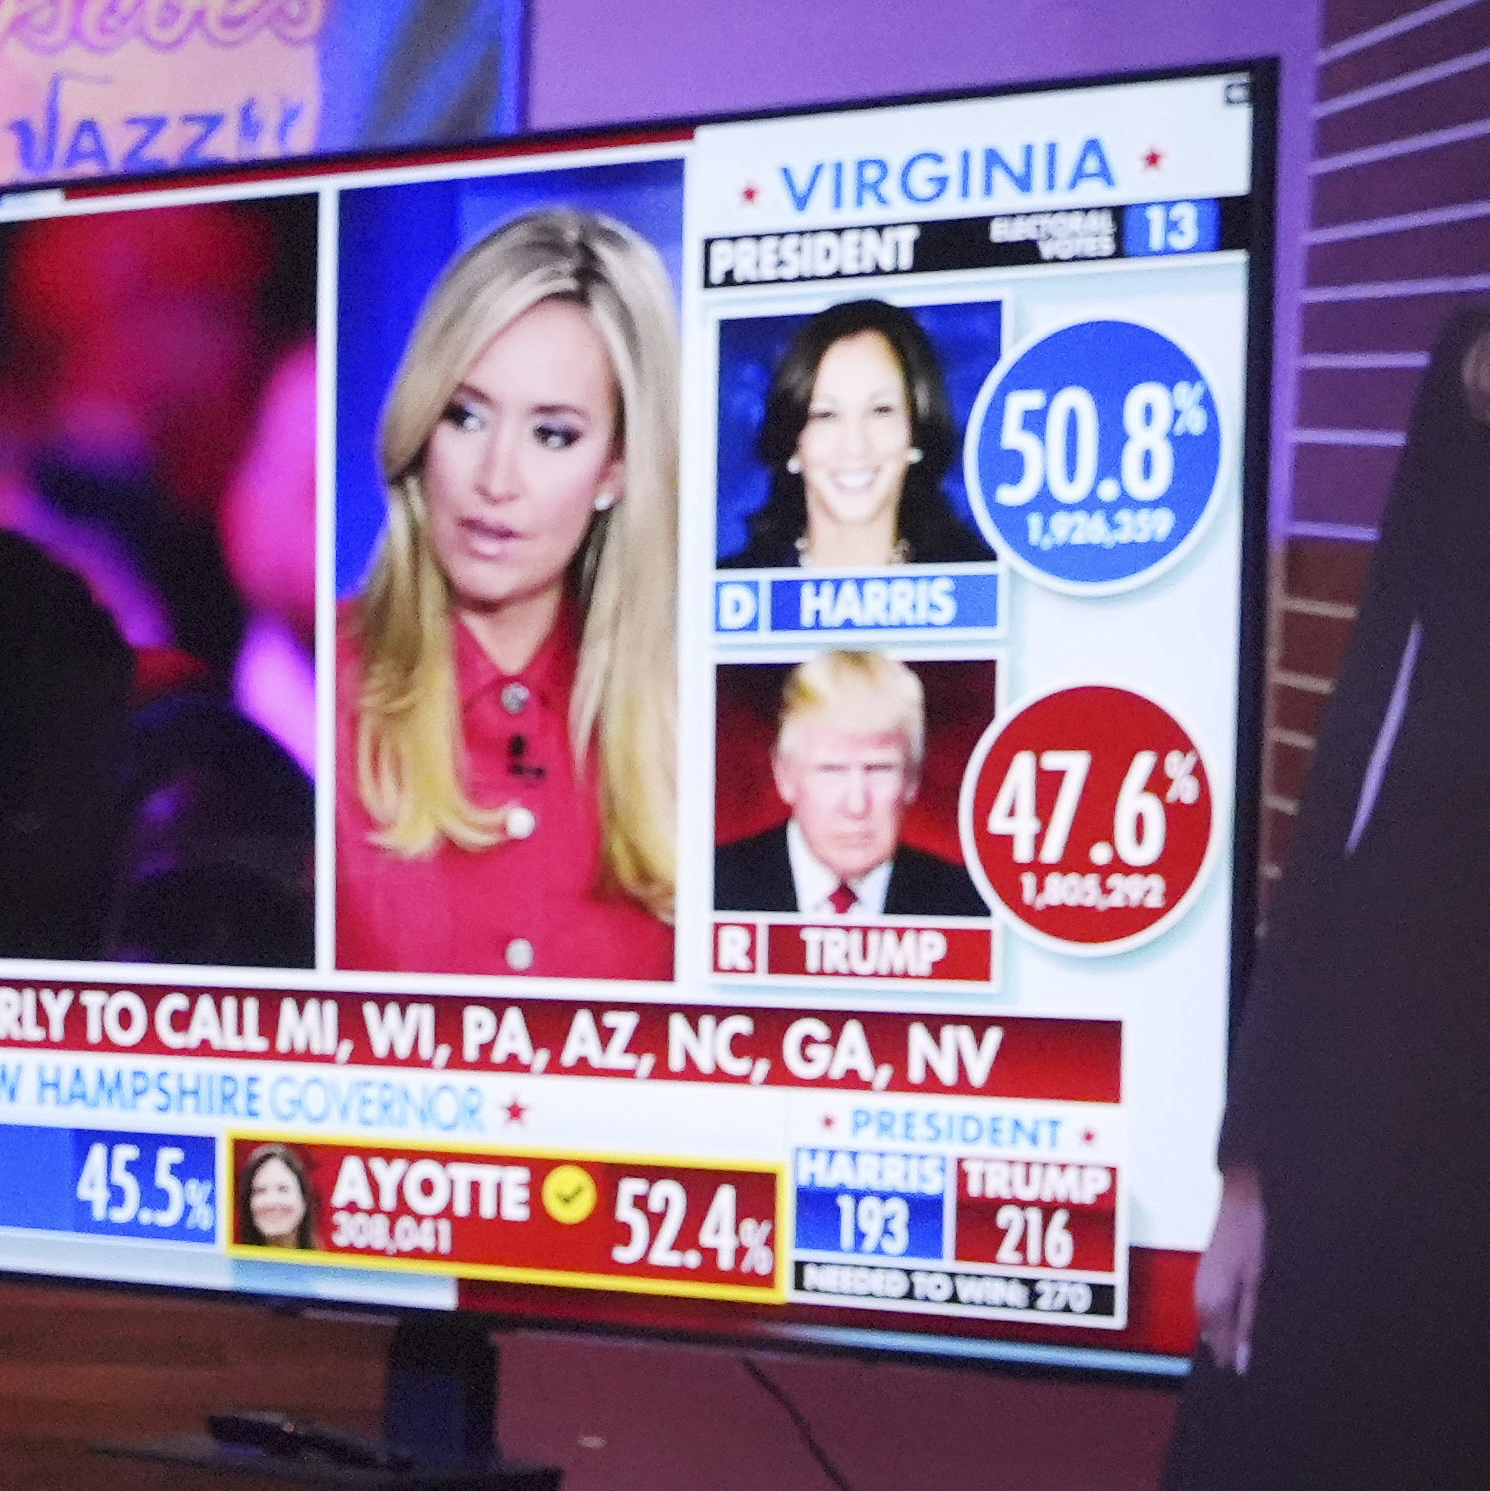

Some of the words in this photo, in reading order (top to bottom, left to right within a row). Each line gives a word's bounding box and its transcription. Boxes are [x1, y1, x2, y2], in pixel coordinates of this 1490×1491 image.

[781, 137, 1117, 213] VIRGINIA
[709, 225, 920, 286] PRESIDENT
[1145, 202, 1200, 254] 13
[994, 380, 1210, 507] 50.8%
[718, 584, 756, 627] D
[800, 577, 958, 628] HARRIS
[986, 747, 1202, 868] 47.6%
[718, 931, 756, 972] R
[800, 931, 949, 978] TRUMP
[79, 990, 148, 1047] TO
[154, 994, 269, 1054] CALL
[275, 996, 355, 1064] MI,
[362, 1000, 452, 1069] WI,
[462, 1004, 551, 1075] PA,
[560, 1008, 655, 1079] AZ,
[668, 1012, 772, 1086] NC,
[782, 1016, 894, 1092] GA,
[906, 1021, 1005, 1088] NV
[36, 1061, 262, 1120] HAMPSHIRE
[269, 1075, 488, 1134] GOVERNOR
[851, 1108, 1064, 1149] PRESIDENT
[77, 1142, 215, 1232] 45.5%
[330, 1155, 532, 1222] AYOTTE
[796, 1149, 945, 1195] HARRIS
[961, 1159, 1112, 1205] TRUMP
[611, 1176, 773, 1277] 52.4%
[836, 1193, 911, 1257] 193
[995, 1205, 1075, 1269] 216
[1034, 1280, 1093, 1314] 270
